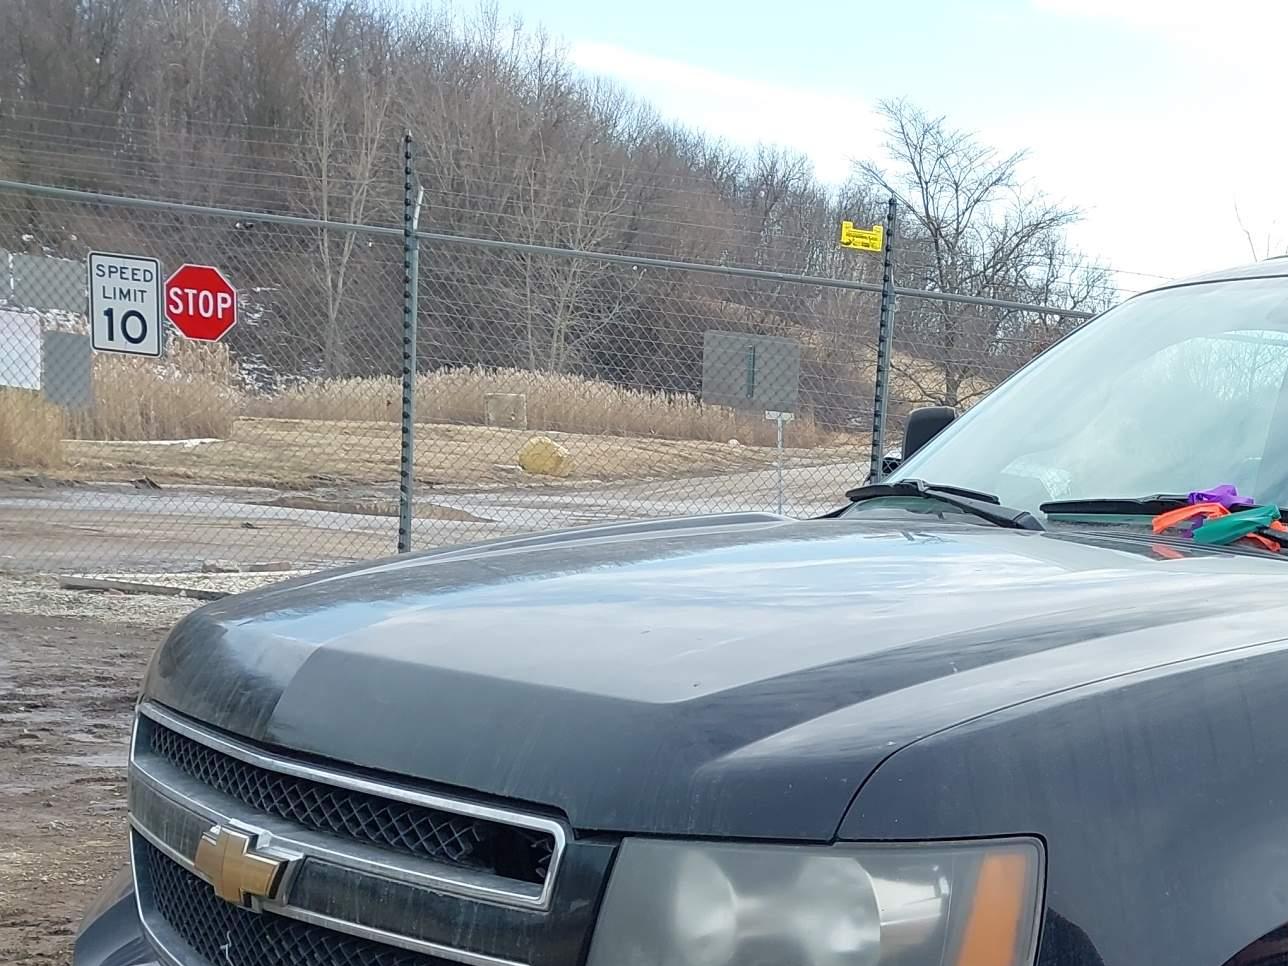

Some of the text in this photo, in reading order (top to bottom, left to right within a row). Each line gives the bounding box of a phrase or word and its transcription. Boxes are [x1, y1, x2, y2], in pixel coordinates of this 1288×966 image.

[95, 264, 154, 283] SPEED
[102, 285, 148, 303] LIMIT
[168, 286, 232, 319] STOP
[103, 307, 148, 345] 10
